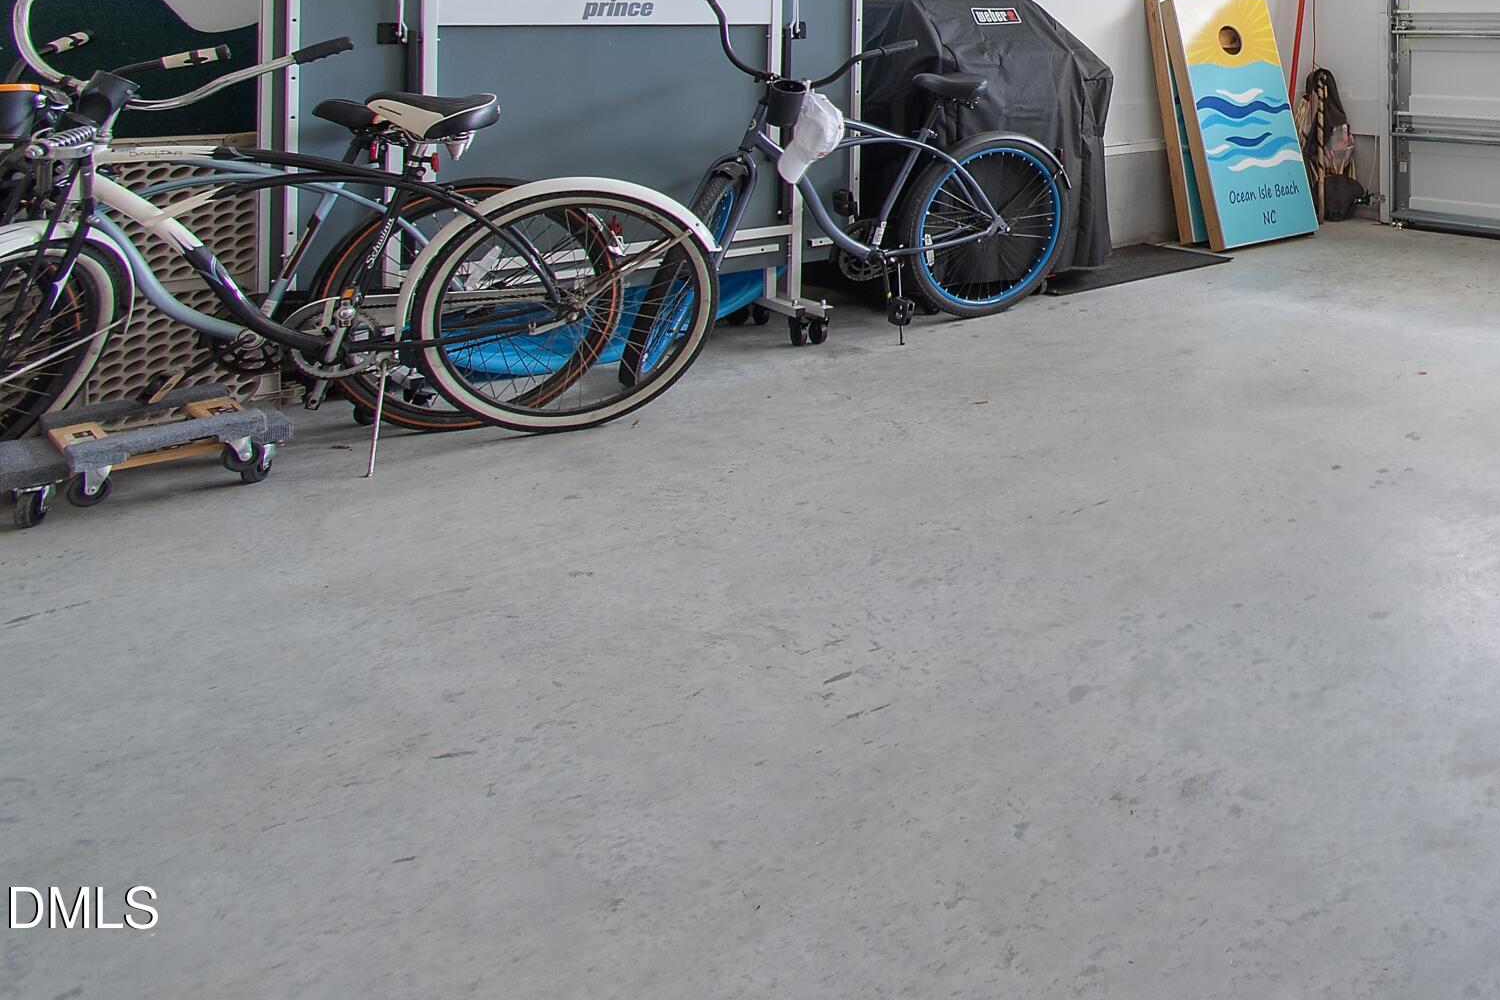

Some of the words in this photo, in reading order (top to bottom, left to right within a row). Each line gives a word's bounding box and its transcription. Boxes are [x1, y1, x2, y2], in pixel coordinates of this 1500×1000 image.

[975, 9, 1008, 22] weber
[1229, 190, 1257, 204] Ocean
[1258, 184, 1273, 199] Isle
[1274, 181, 1300, 198] Beach
[1262, 209, 1277, 225] NC
[366, 217, 395, 269] Schwinn
